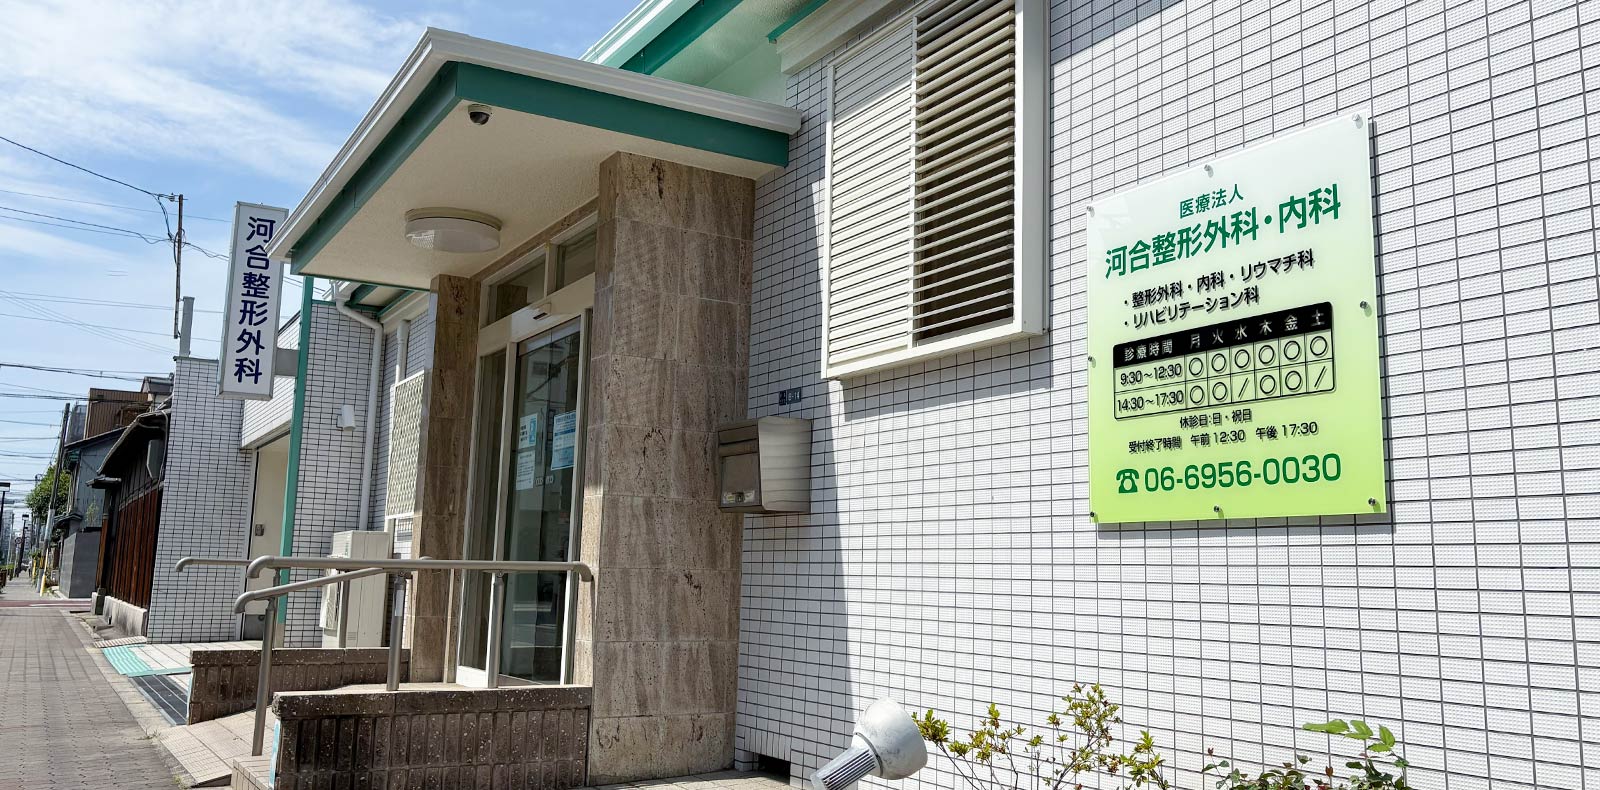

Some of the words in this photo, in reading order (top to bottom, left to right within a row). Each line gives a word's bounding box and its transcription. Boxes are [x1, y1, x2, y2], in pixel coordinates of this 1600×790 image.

[1180, 184, 1244, 219] 医療法人
[1105, 184, 1341, 279] 河合整形外科・内科
[234, 216, 276, 385] 河合整形外科
[1124, 340, 1173, 362] 診療時間
[1190, 333, 1201, 349] 月
[1212, 328, 1224, 344] 火
[1235, 324, 1248, 341] 水
[1259, 319, 1274, 336] 木
[1284, 315, 1298, 331] 金
[1310, 309, 1325, 326] 土
[1128, 436, 1182, 453] 受付終了時間
[1144, 453, 1341, 492] 06-6956-0030
